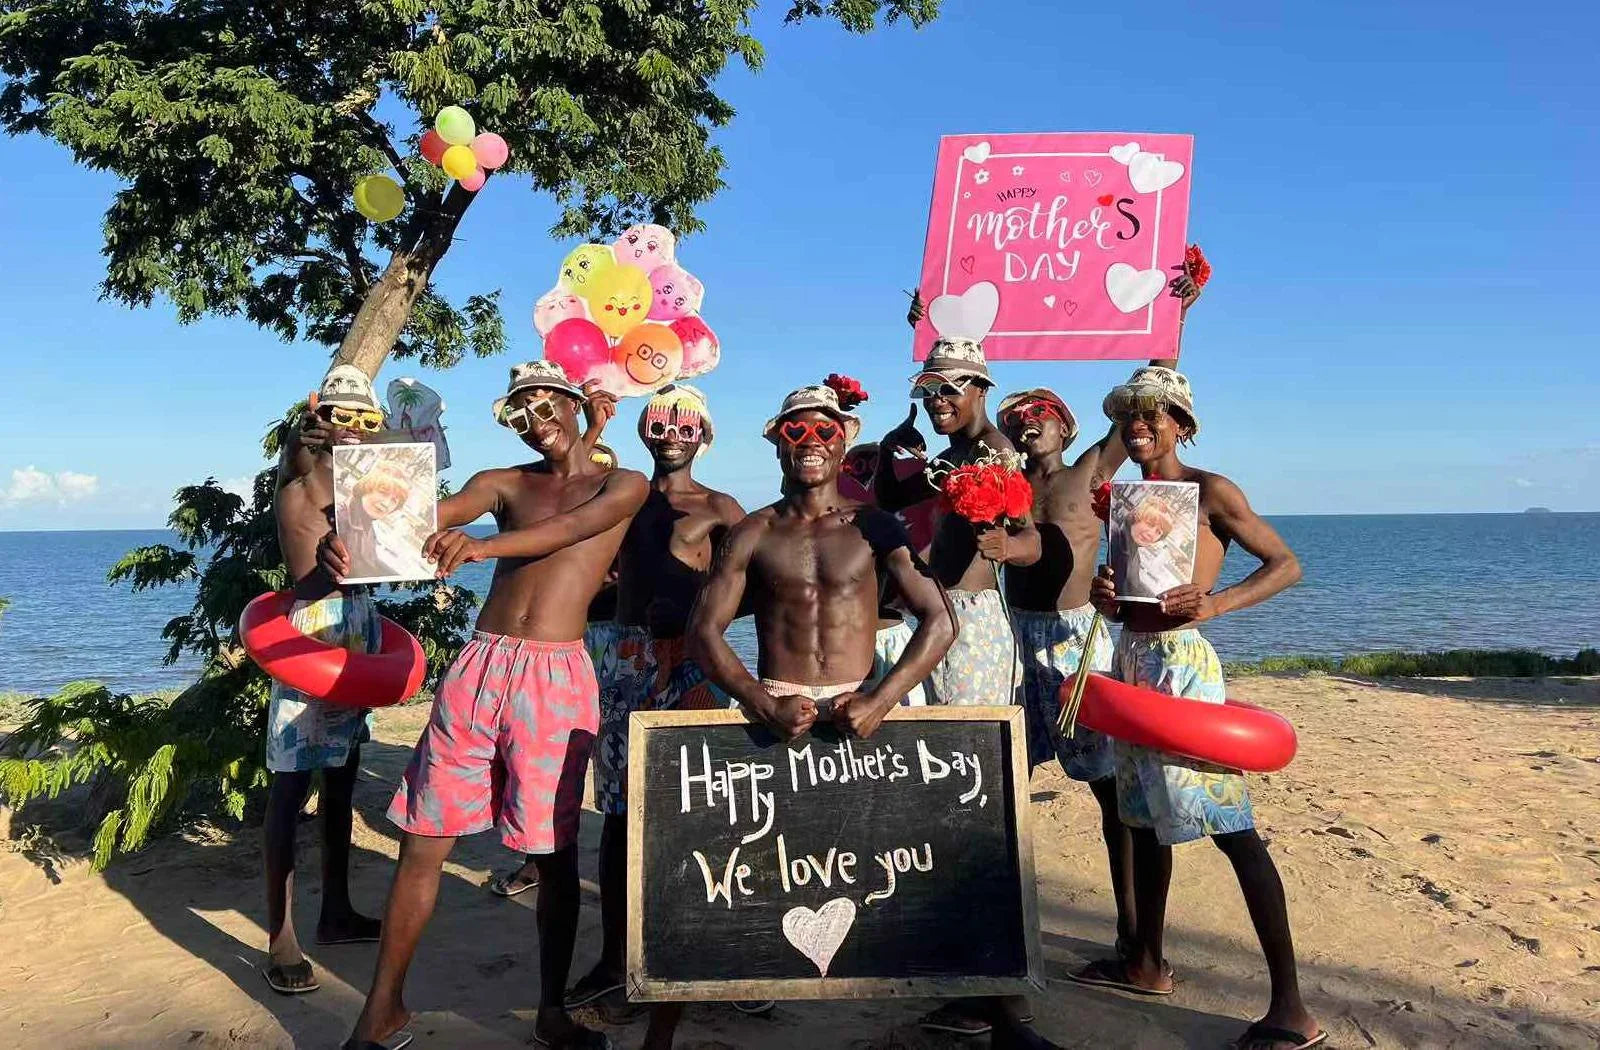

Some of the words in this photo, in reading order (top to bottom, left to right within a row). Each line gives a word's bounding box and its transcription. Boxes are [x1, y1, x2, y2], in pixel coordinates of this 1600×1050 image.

[996, 187, 1038, 202] HAPPY
[1004, 251, 1081, 282] DAY
[680, 739, 775, 844] Happy
[787, 739, 909, 793] Mother's
[916, 740, 987, 808] Day,
[693, 847, 754, 909] We
[777, 834, 857, 892] love
[865, 843, 933, 904] you
